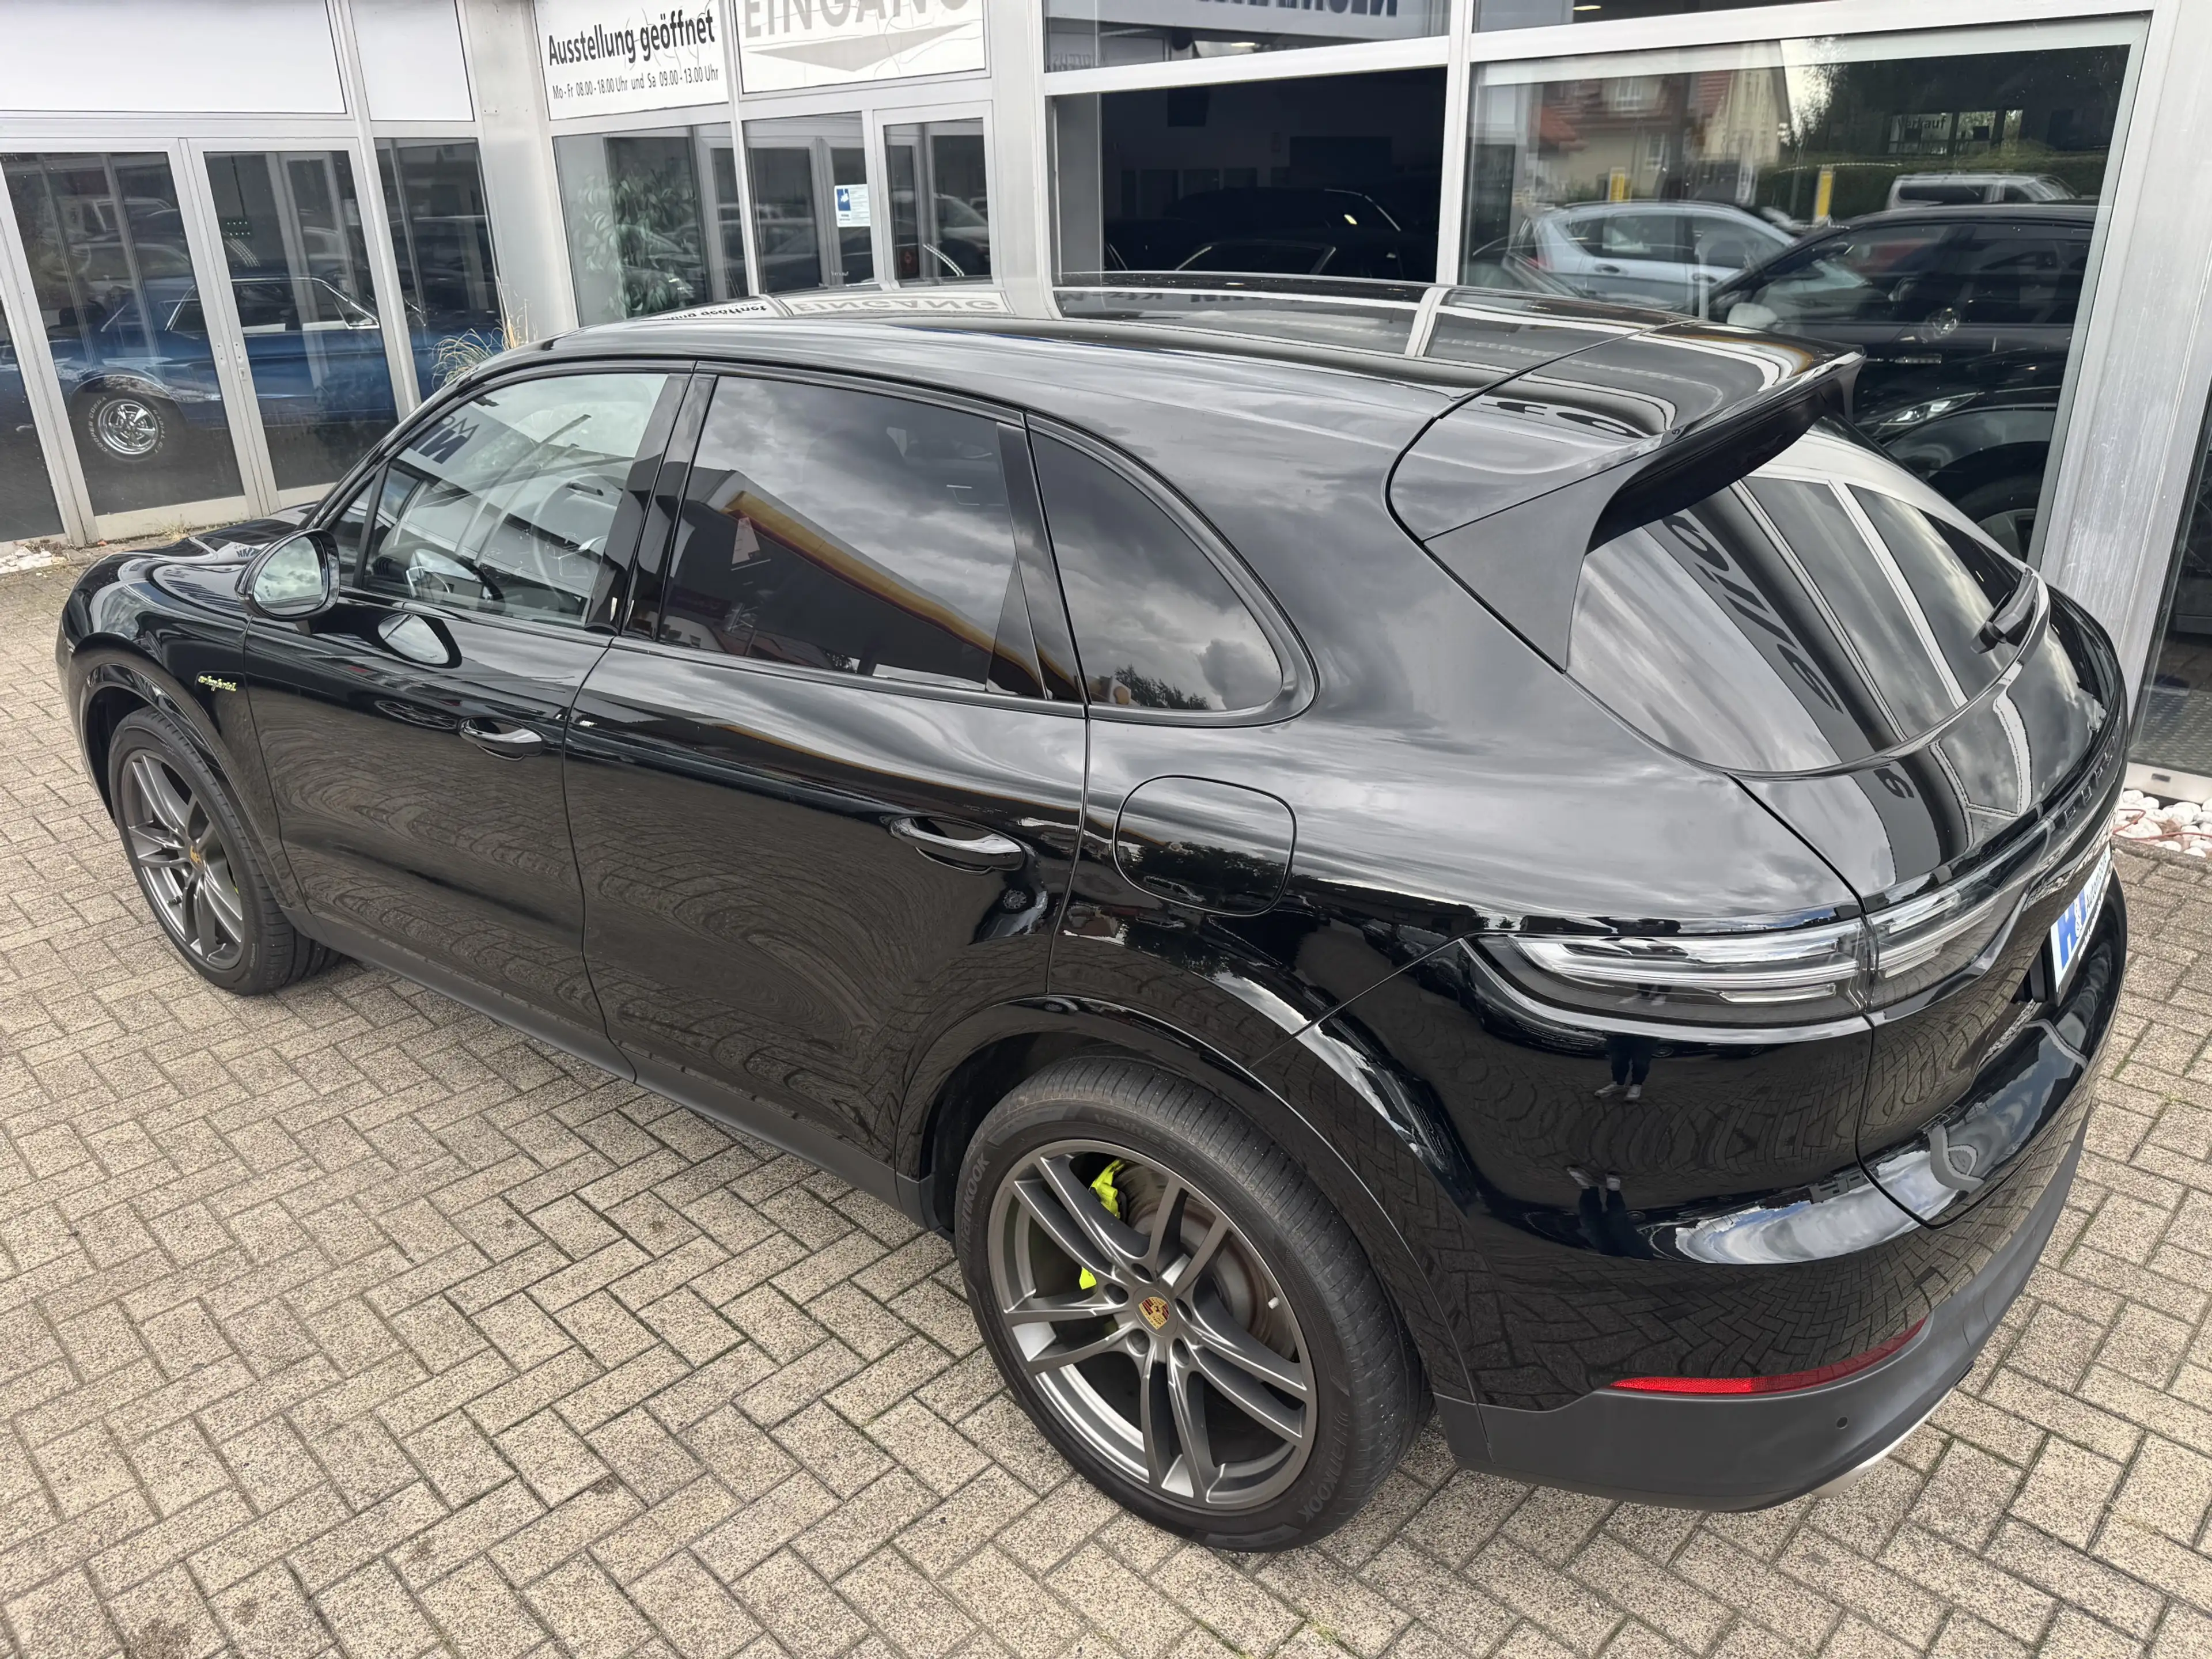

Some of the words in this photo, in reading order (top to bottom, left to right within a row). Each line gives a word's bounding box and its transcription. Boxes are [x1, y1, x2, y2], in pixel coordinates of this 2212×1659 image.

[549, 24, 636, 66] Ausstellung
[640, 9, 715, 61] geöffnet
[576, 82, 593, 97] 08.00
[597, 79, 615, 94] 18.00
[616, 76, 628, 91] Uhr
[631, 73, 645, 90] und
[647, 73, 656, 88] Sa
[659, 70, 678, 86] 09.00
[704, 64, 718, 81] Uhr
